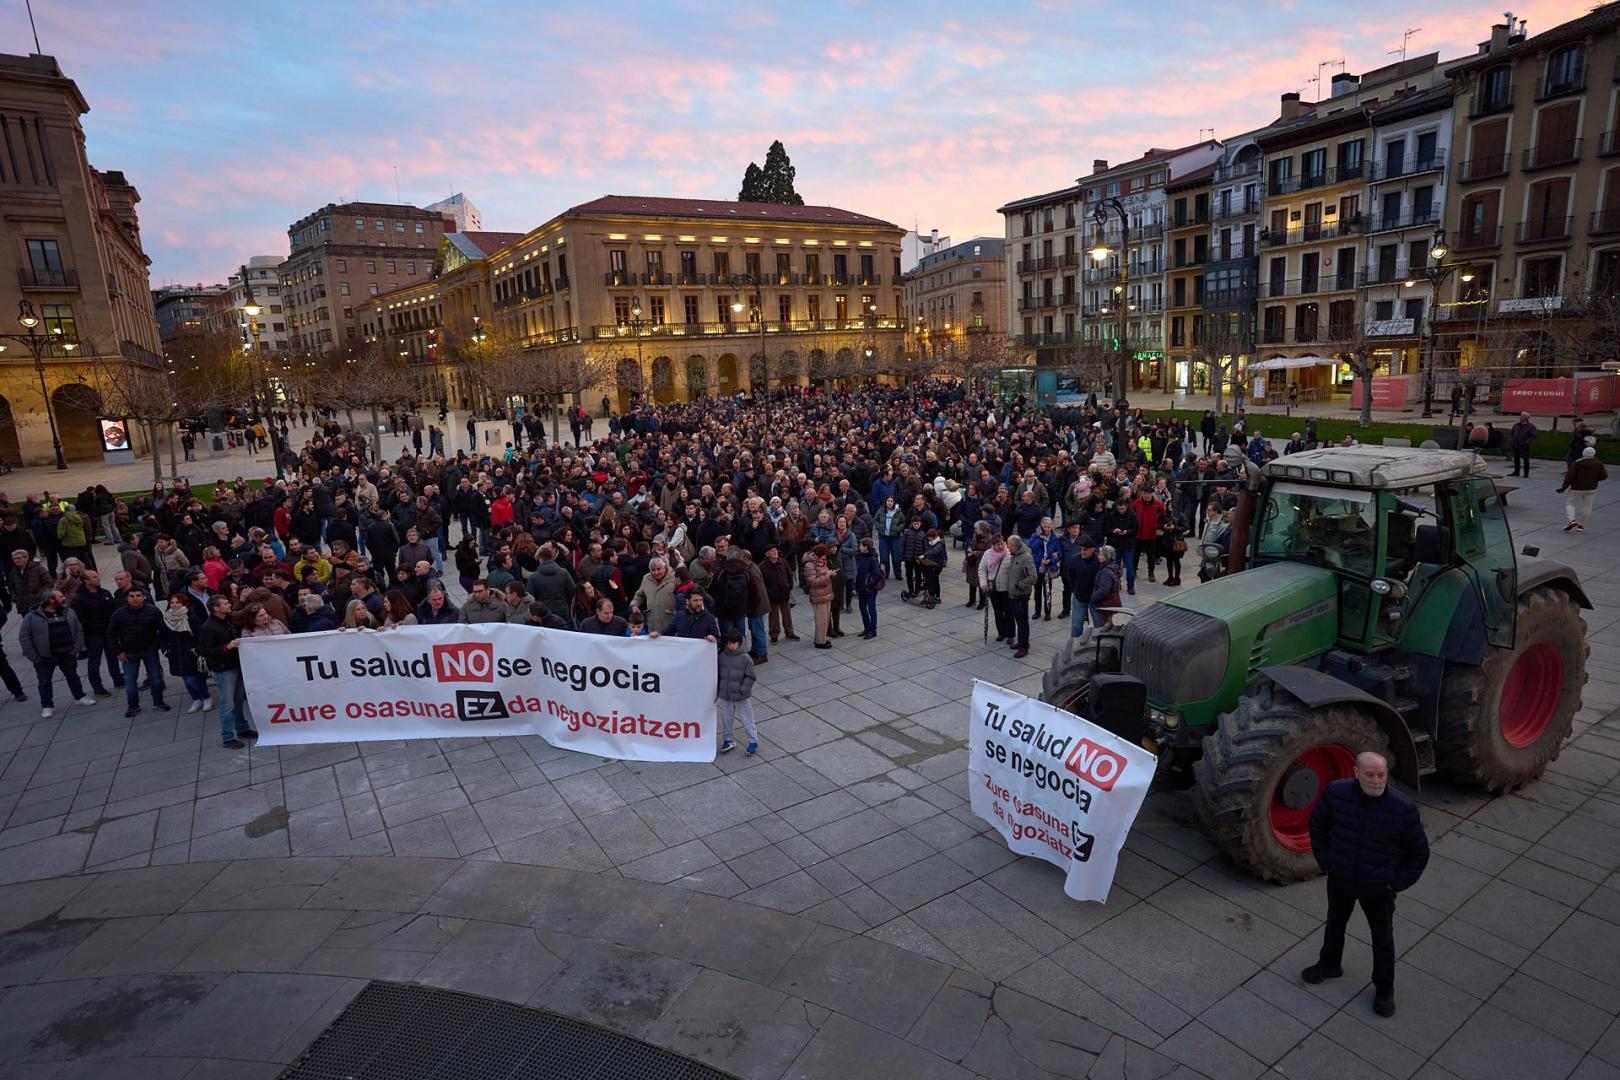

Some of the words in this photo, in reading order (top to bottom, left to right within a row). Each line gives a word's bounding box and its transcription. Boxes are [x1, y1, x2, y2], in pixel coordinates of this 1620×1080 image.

[296, 655, 339, 681] Tu
[350, 652, 432, 678] salud
[441, 649, 490, 677] NO
[497, 657, 532, 678] se
[541, 656, 661, 694] negocia
[267, 703, 337, 724] Zure
[345, 700, 455, 719] osasuna
[463, 697, 502, 718] EZ
[507, 695, 542, 714] da
[547, 699, 701, 739] negoziatzen
[984, 702, 1007, 732] Tu
[1009, 719, 1073, 760] salud
[1069, 743, 1119, 783] NO
[984, 773, 1010, 802] Zure
[985, 739, 1007, 763] se
[1011, 751, 1093, 814] negocia
[992, 800, 1004, 819] da
